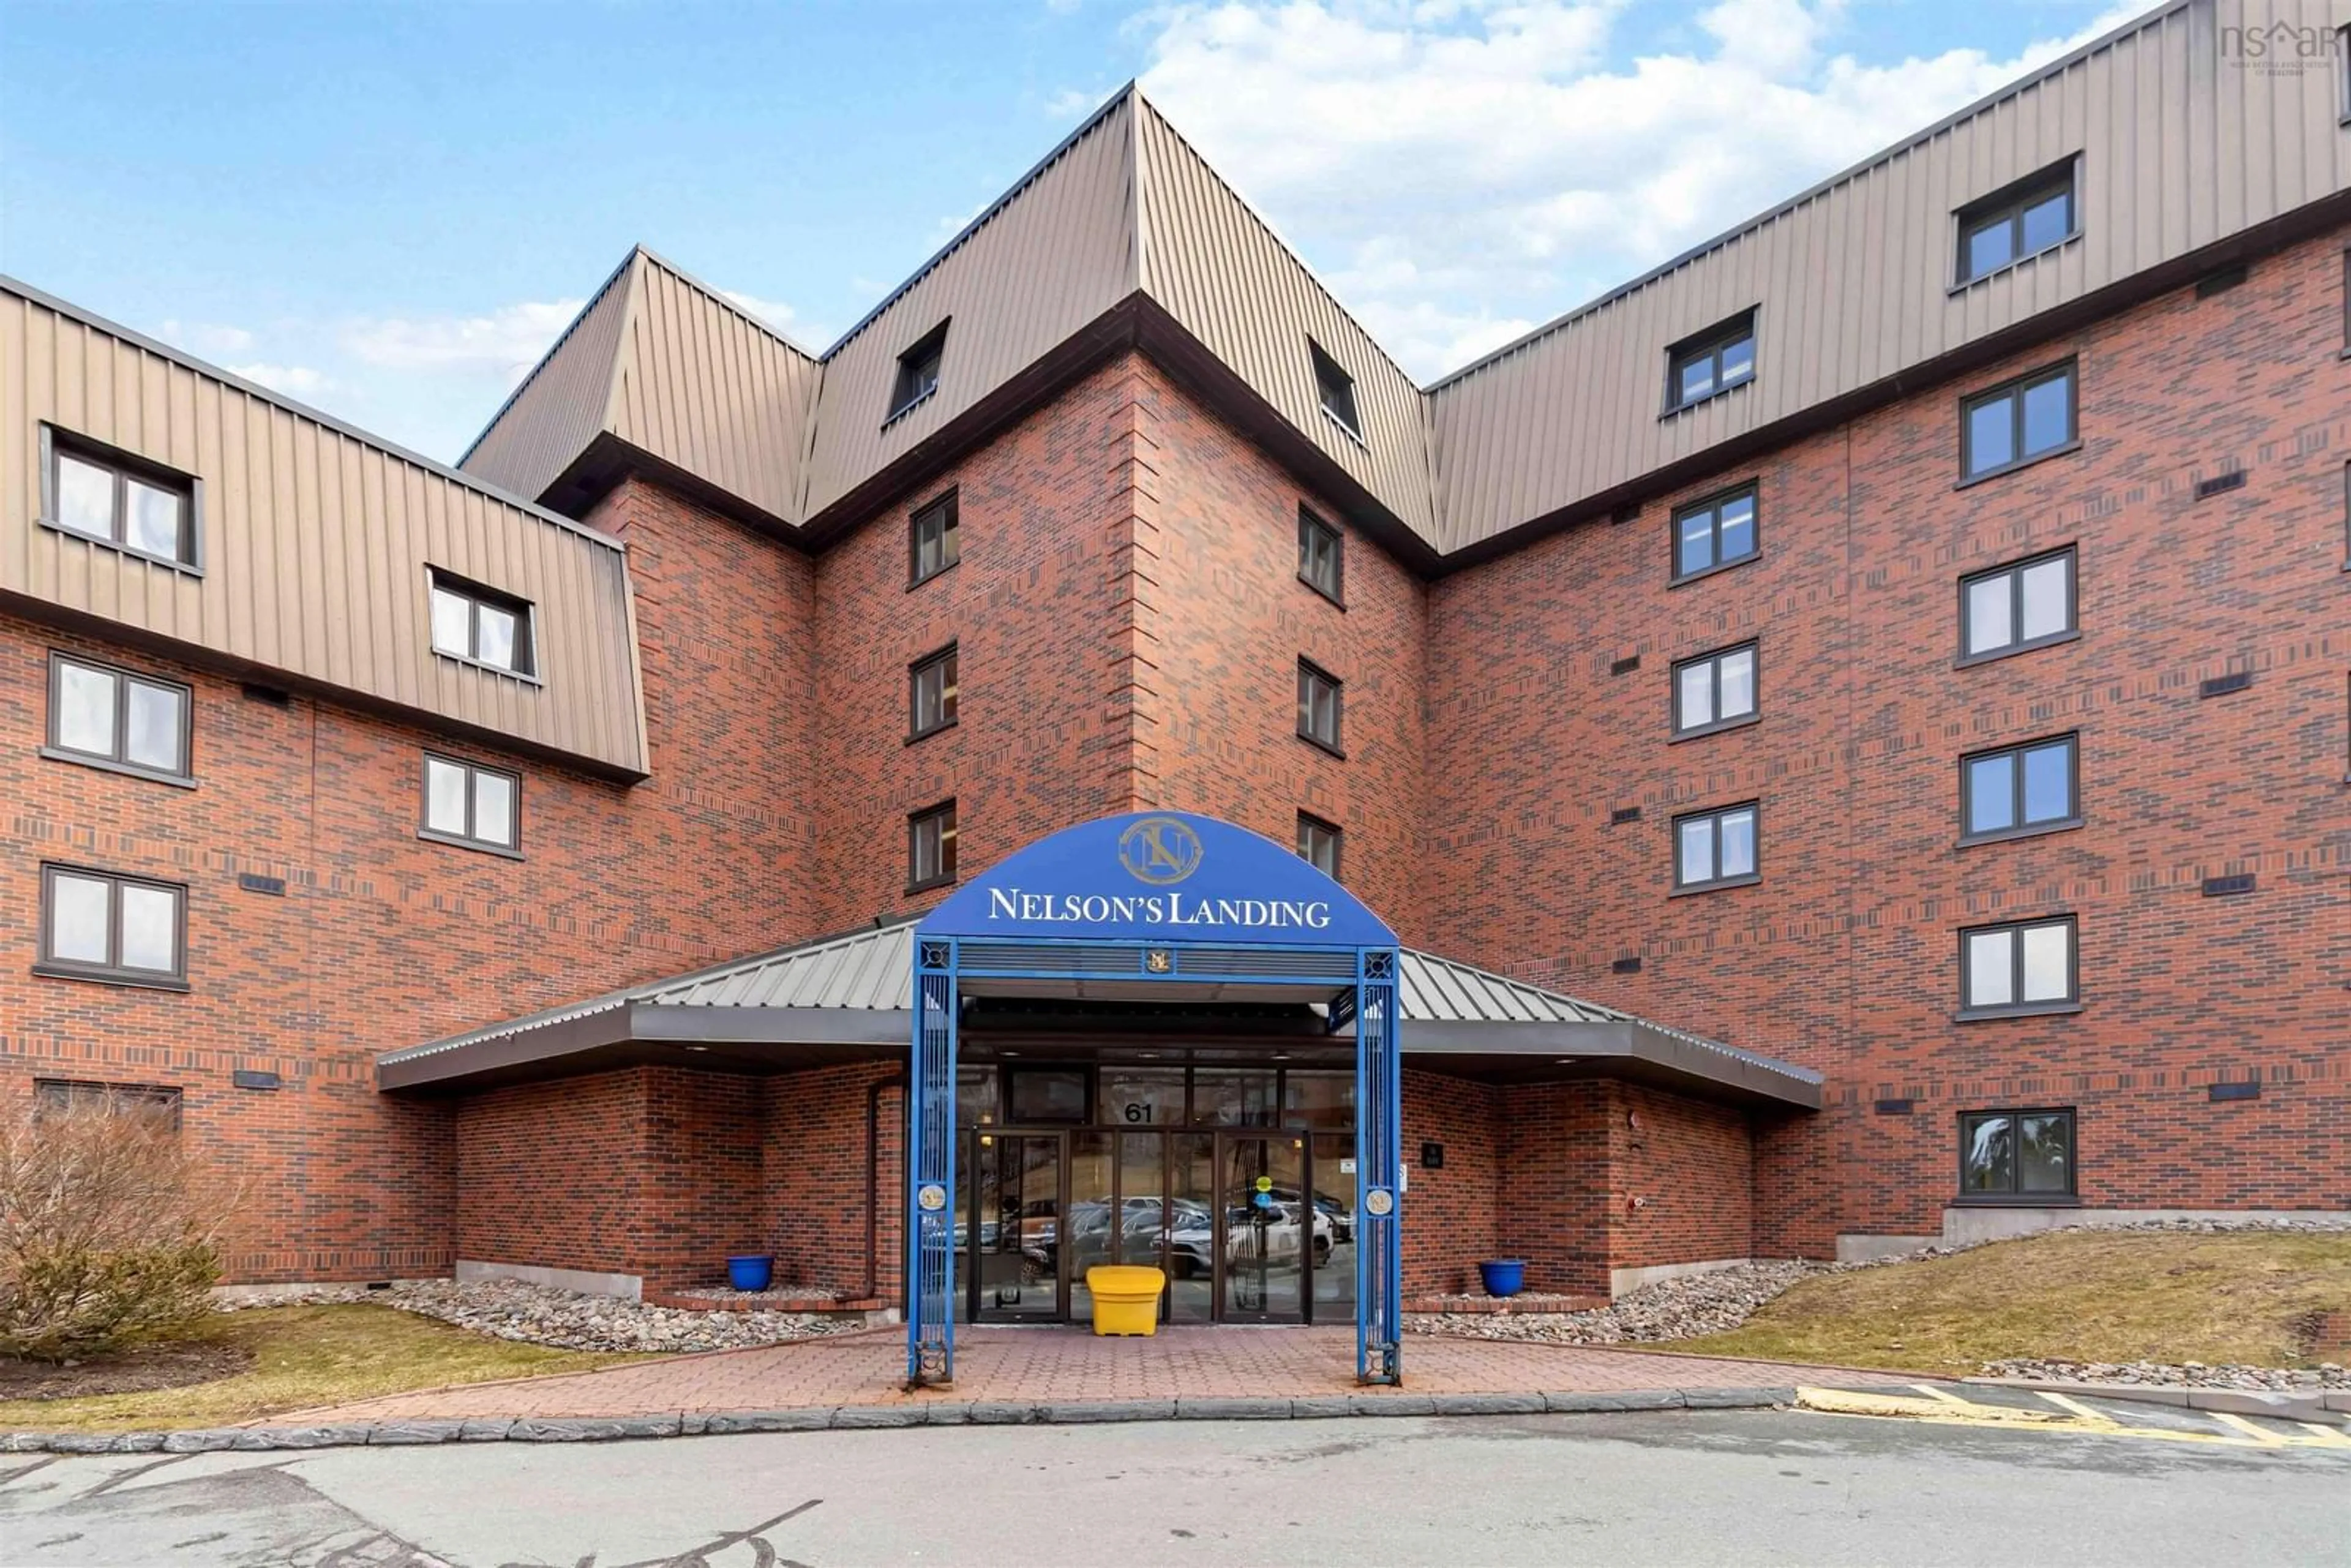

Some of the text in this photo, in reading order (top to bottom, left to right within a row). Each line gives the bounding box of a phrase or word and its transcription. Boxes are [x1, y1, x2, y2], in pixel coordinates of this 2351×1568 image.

[988, 888, 1331, 928] NELSON’S LANDING
[1125, 1103, 1152, 1123] 61
